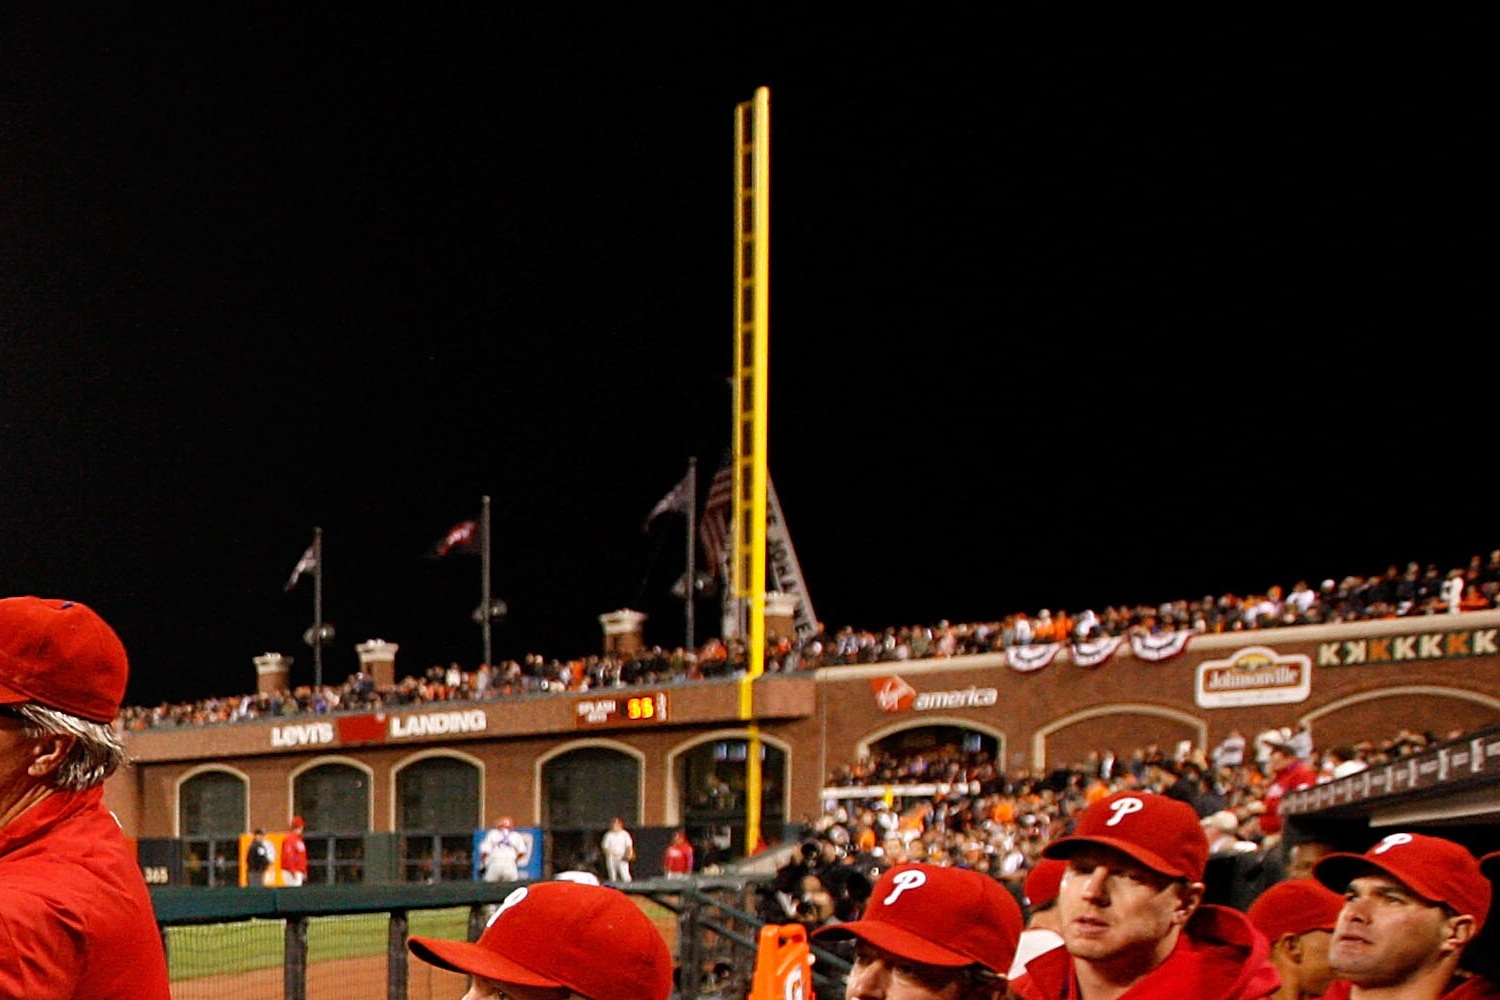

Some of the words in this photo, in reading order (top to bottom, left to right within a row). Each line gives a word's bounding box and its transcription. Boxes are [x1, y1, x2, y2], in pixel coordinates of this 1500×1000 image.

[1208, 664, 1298, 689] Johnsonville
[914, 686, 998, 711] america
[390, 709, 488, 738] LANDING
[1107, 797, 1145, 827] P
[883, 868, 927, 906] P
